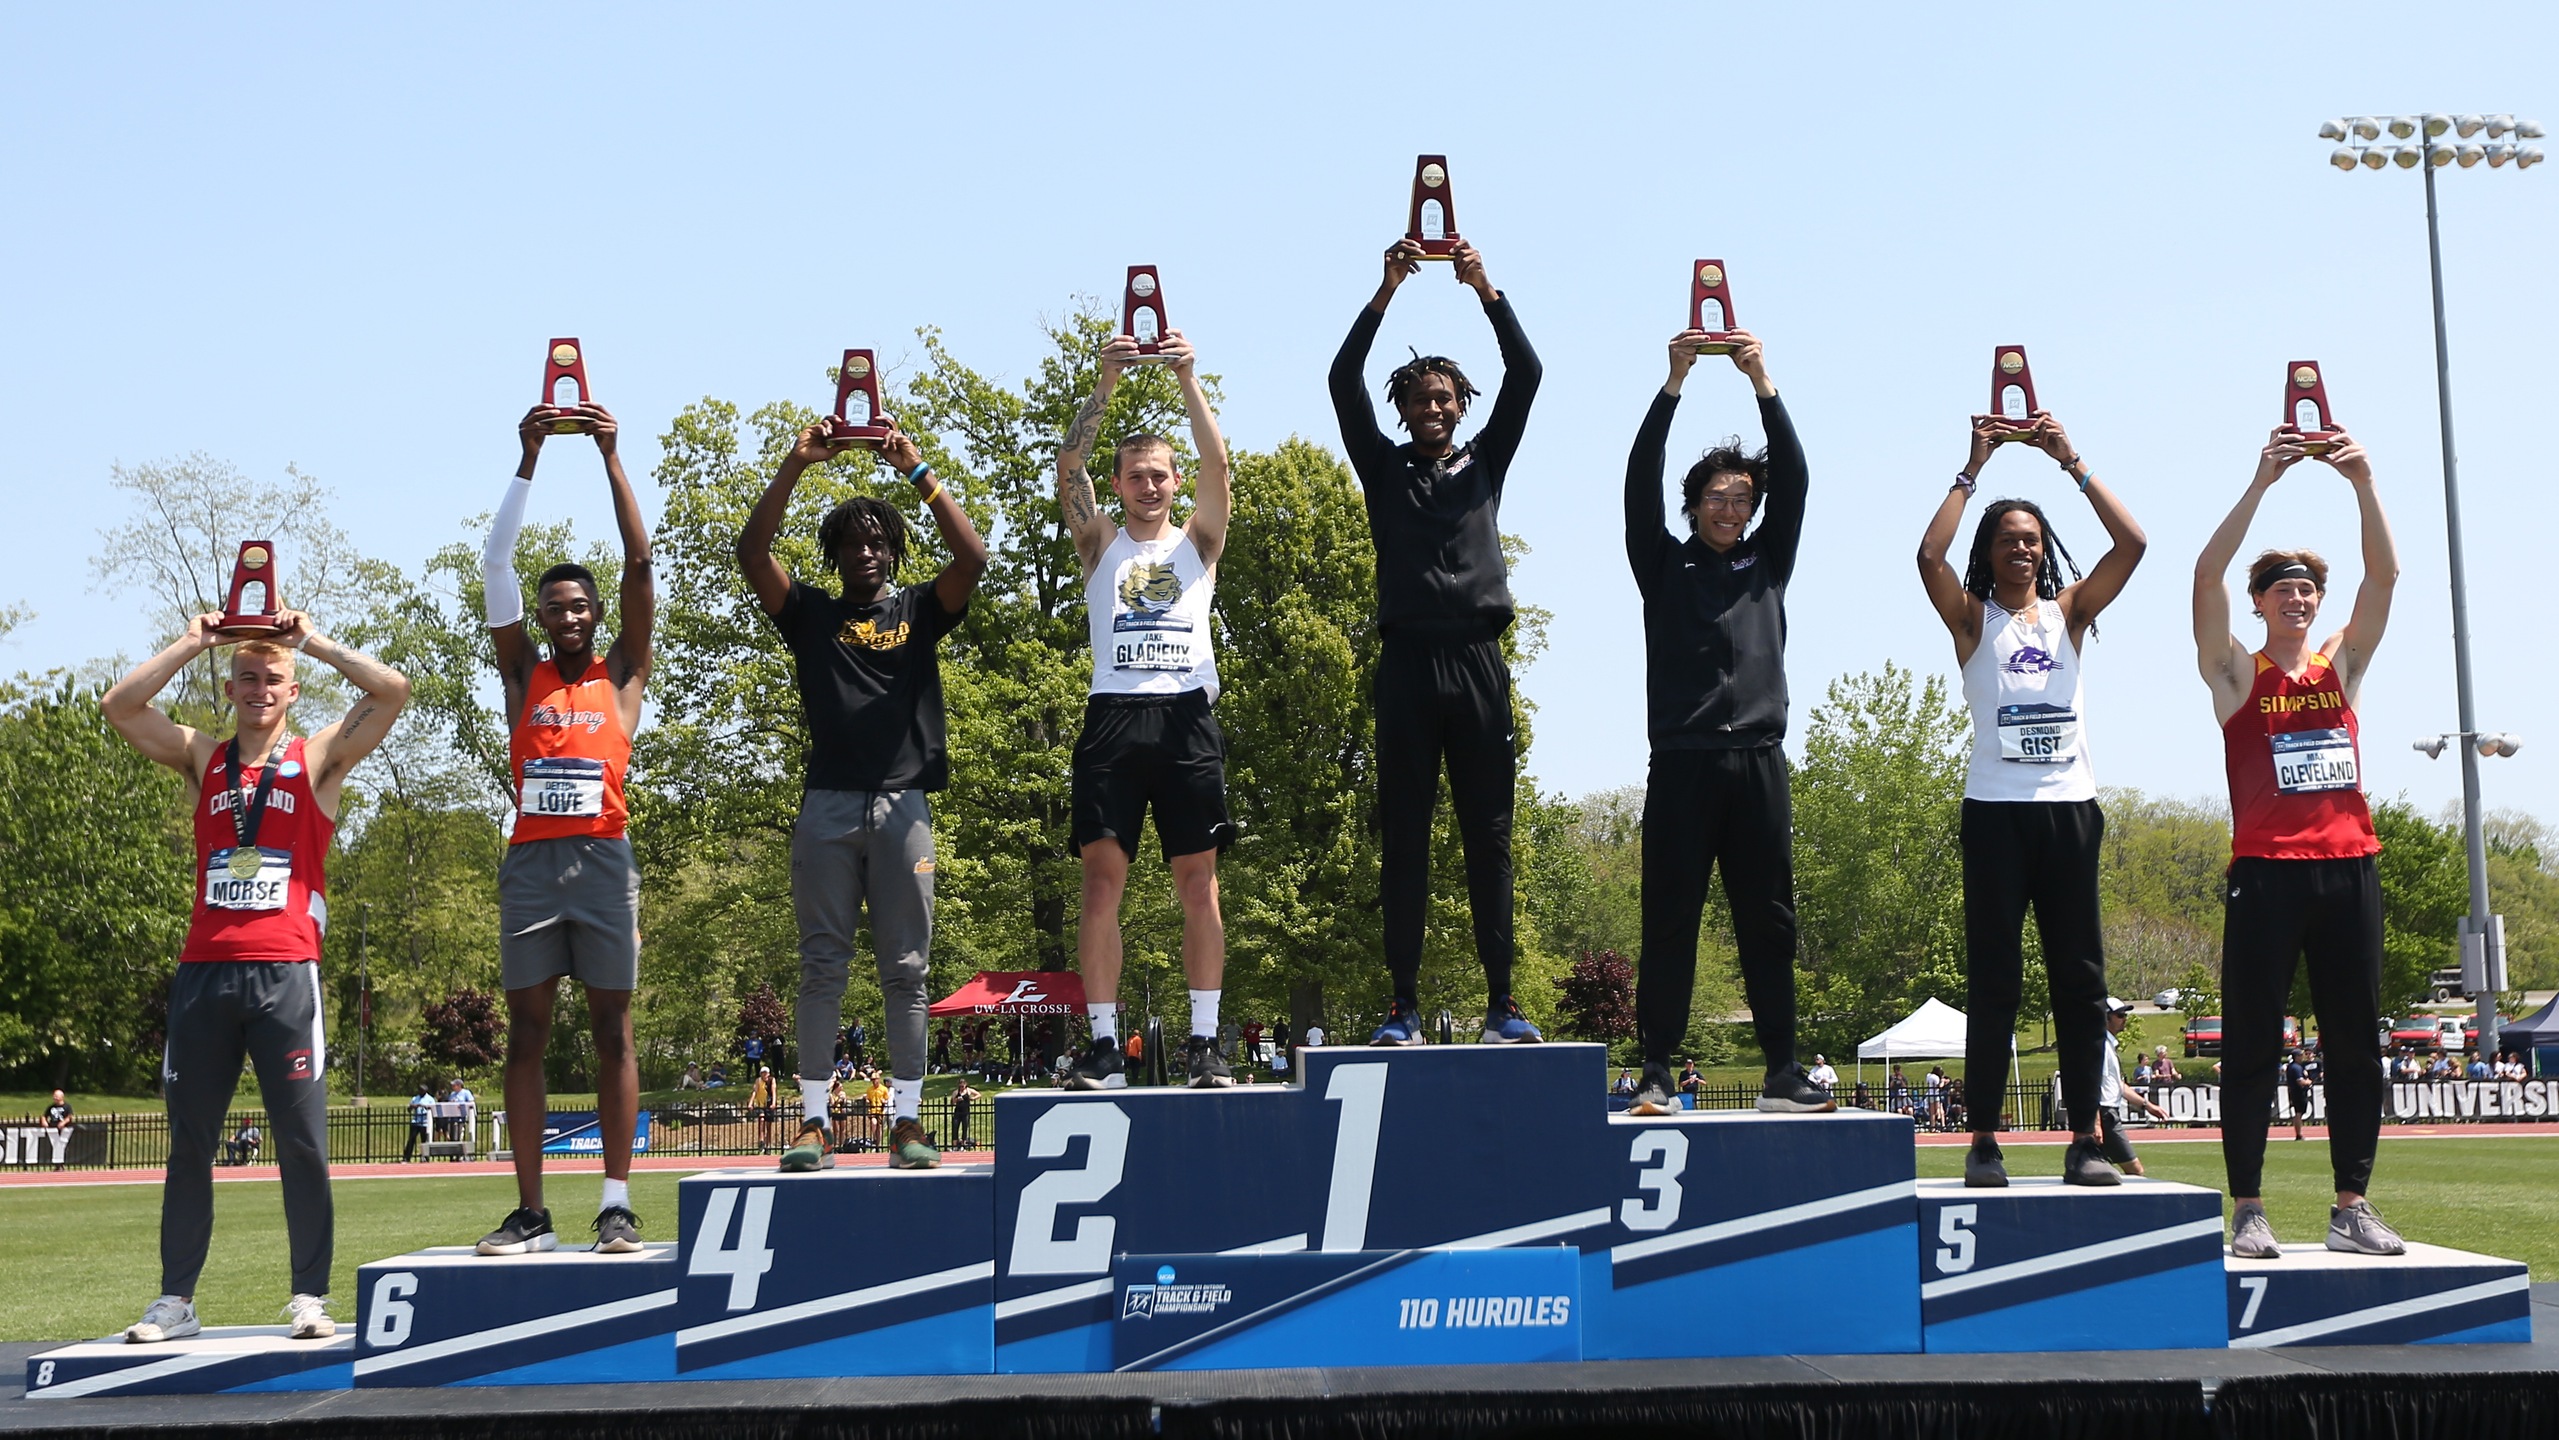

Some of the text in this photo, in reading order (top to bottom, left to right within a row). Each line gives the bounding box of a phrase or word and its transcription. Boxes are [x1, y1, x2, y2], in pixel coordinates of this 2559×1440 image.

[1143, 633, 1164, 641] JAKE
[1116, 643, 1190, 664] GLADIEUX
[2259, 690, 2343, 714] SIMPSON
[2020, 725, 2061, 737] DESMOND
[2021, 736, 2062, 756] GIST
[2306, 753, 2325, 762] MAX
[2280, 761, 2354, 786] CLEVELAND
[538, 791, 584, 812] LOVE
[213, 880, 282, 902] MORSE
[974, 1004, 1072, 1014] UW-LA CROSSE
[0, 1127, 74, 1164] ITY
[1321, 1063, 1389, 1252] 1
[1009, 1102, 1131, 1276] 2
[1620, 1129, 1689, 1231] 3
[688, 1186, 776, 1311] 4
[1936, 1203, 1978, 1273] 5
[1154, 1302, 1216, 1313] CHAMPIONSHIPS
[1156, 1289, 1232, 1304] TRACK & FIELD
[2239, 1276, 2268, 1329] 7
[366, 1272, 419, 1348] 6
[1399, 1296, 1571, 1329] 110 HURDLES
[36, 1361, 56, 1387] 8
